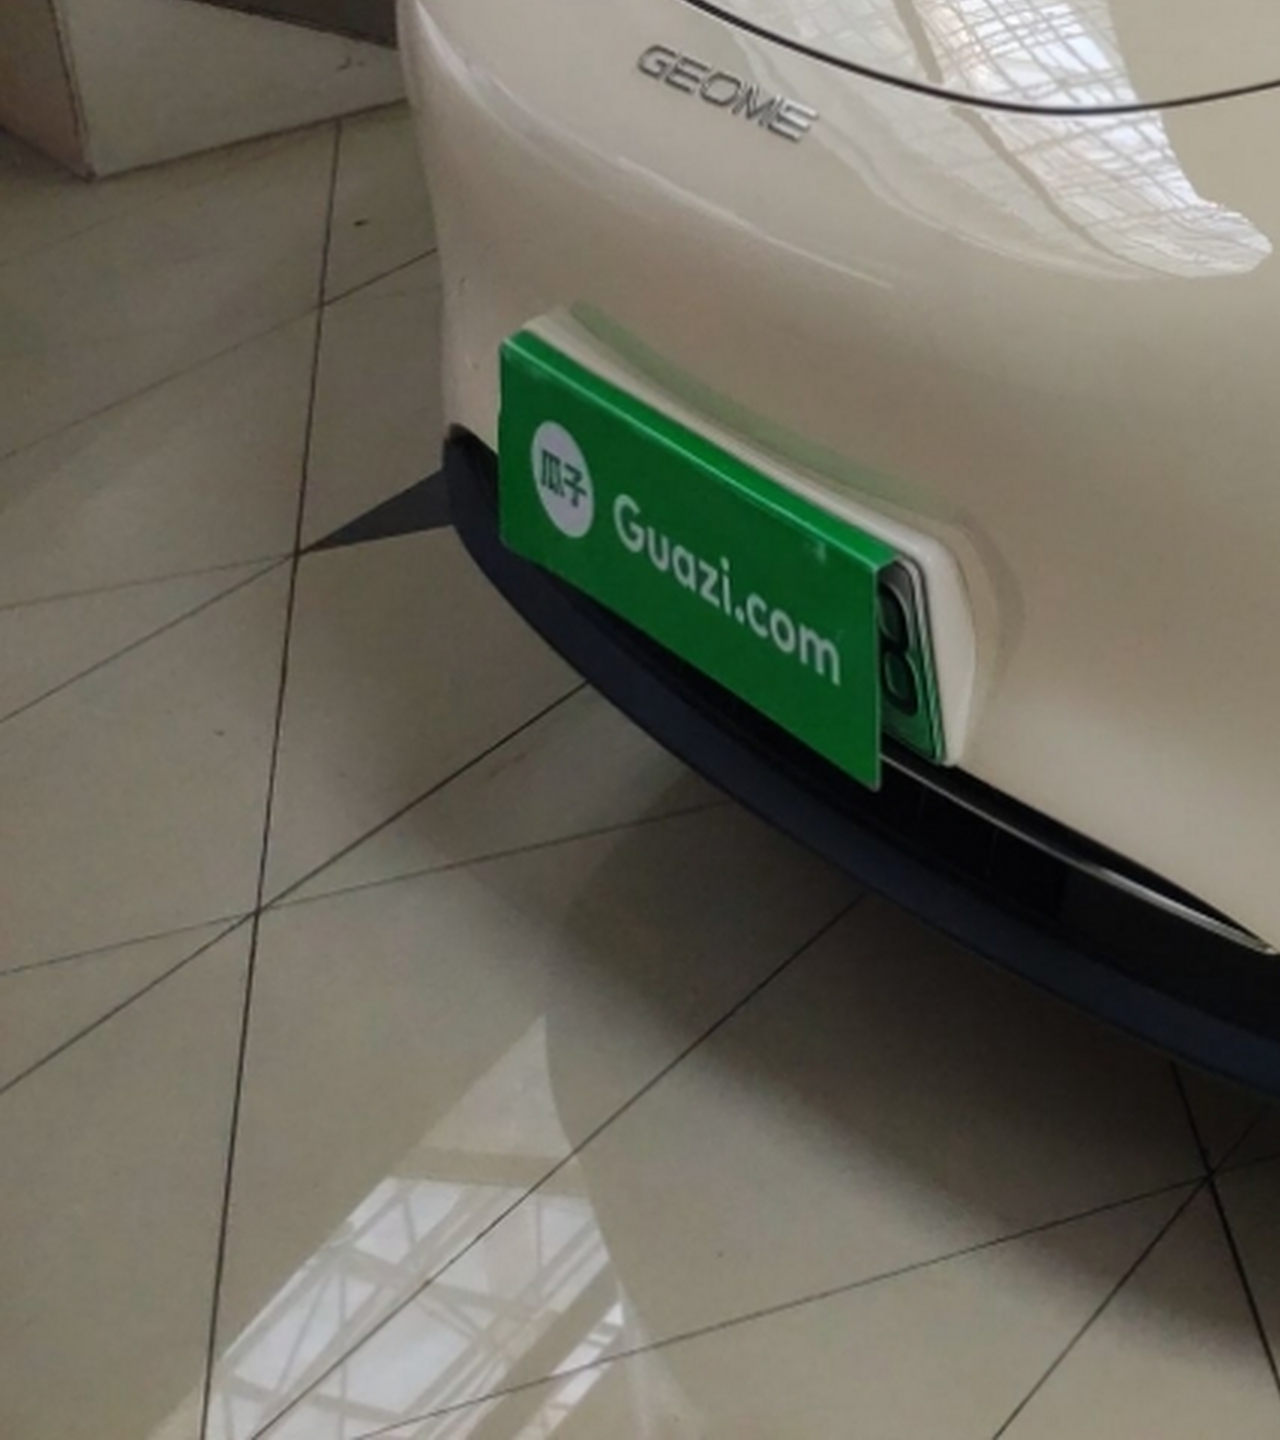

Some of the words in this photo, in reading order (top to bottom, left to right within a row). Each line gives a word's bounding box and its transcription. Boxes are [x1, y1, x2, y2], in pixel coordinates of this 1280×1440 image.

[636, 44, 819, 143] GEOME
[540, 449, 588, 509] 瓜子
[612, 493, 842, 687] Guazi.com
